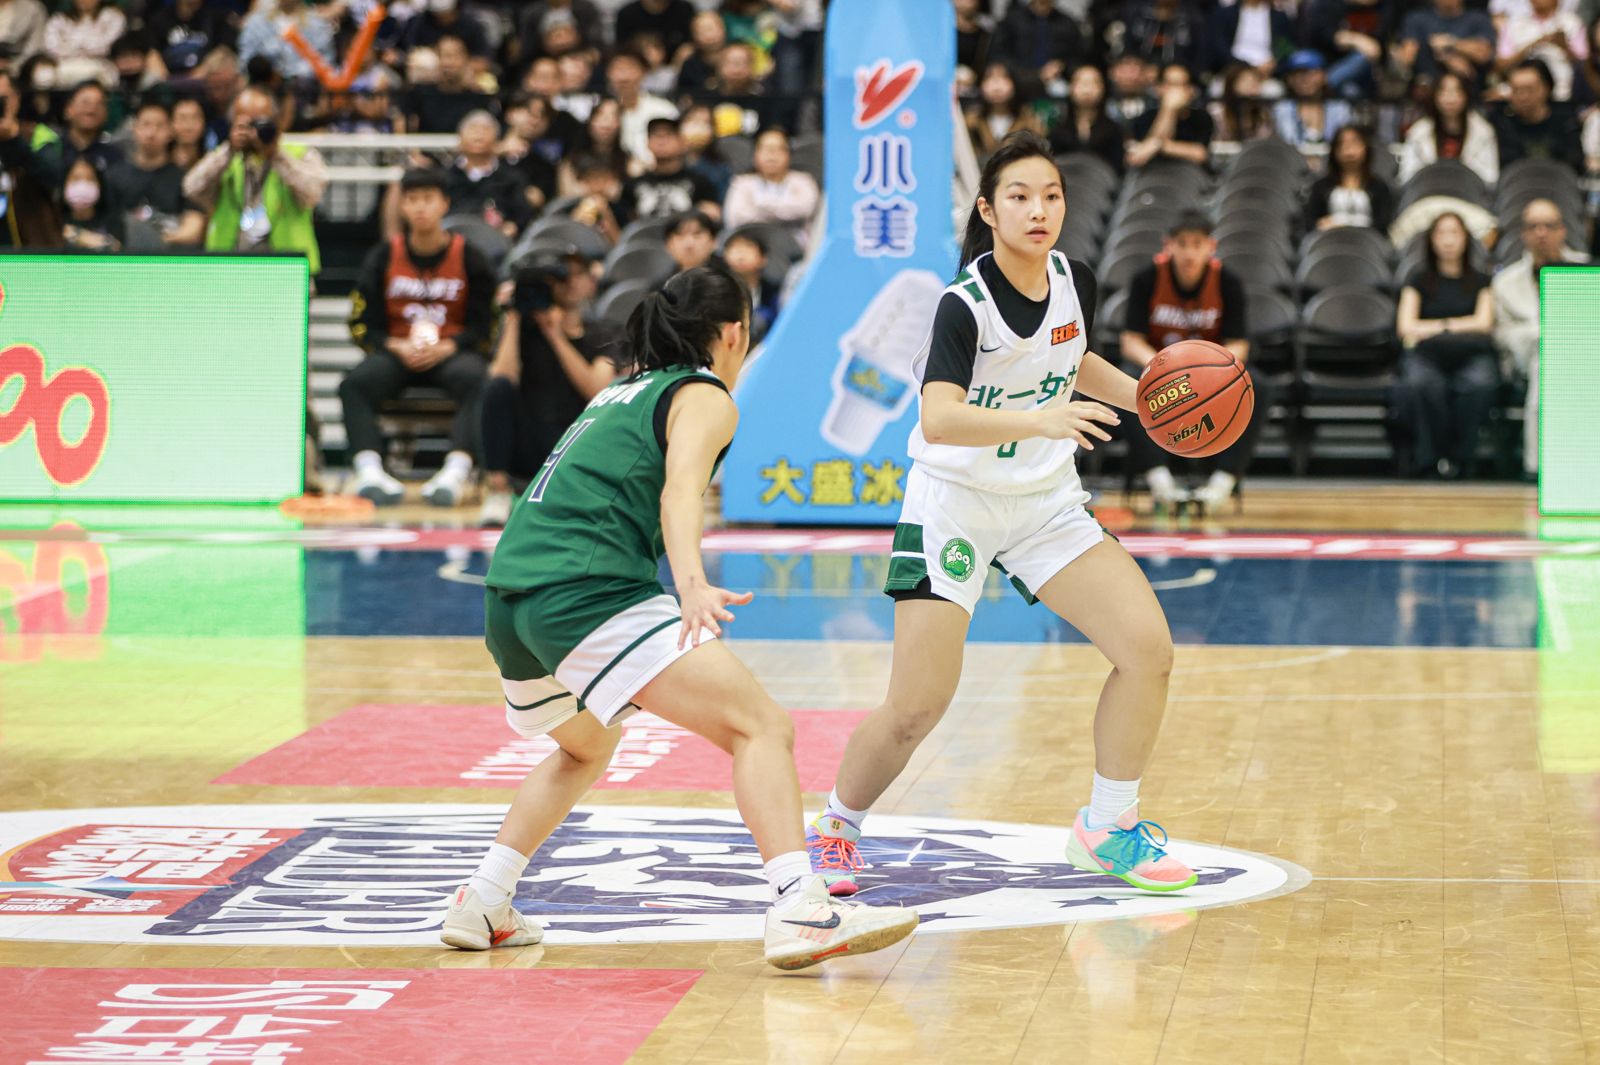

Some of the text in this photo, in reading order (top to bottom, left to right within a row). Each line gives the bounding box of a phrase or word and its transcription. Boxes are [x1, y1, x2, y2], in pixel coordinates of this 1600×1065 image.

[853, 131, 917, 257] 小美
[1051, 320, 1080, 345] HBL
[1148, 382, 1192, 412] 3600
[1173, 412, 1215, 443] Vega
